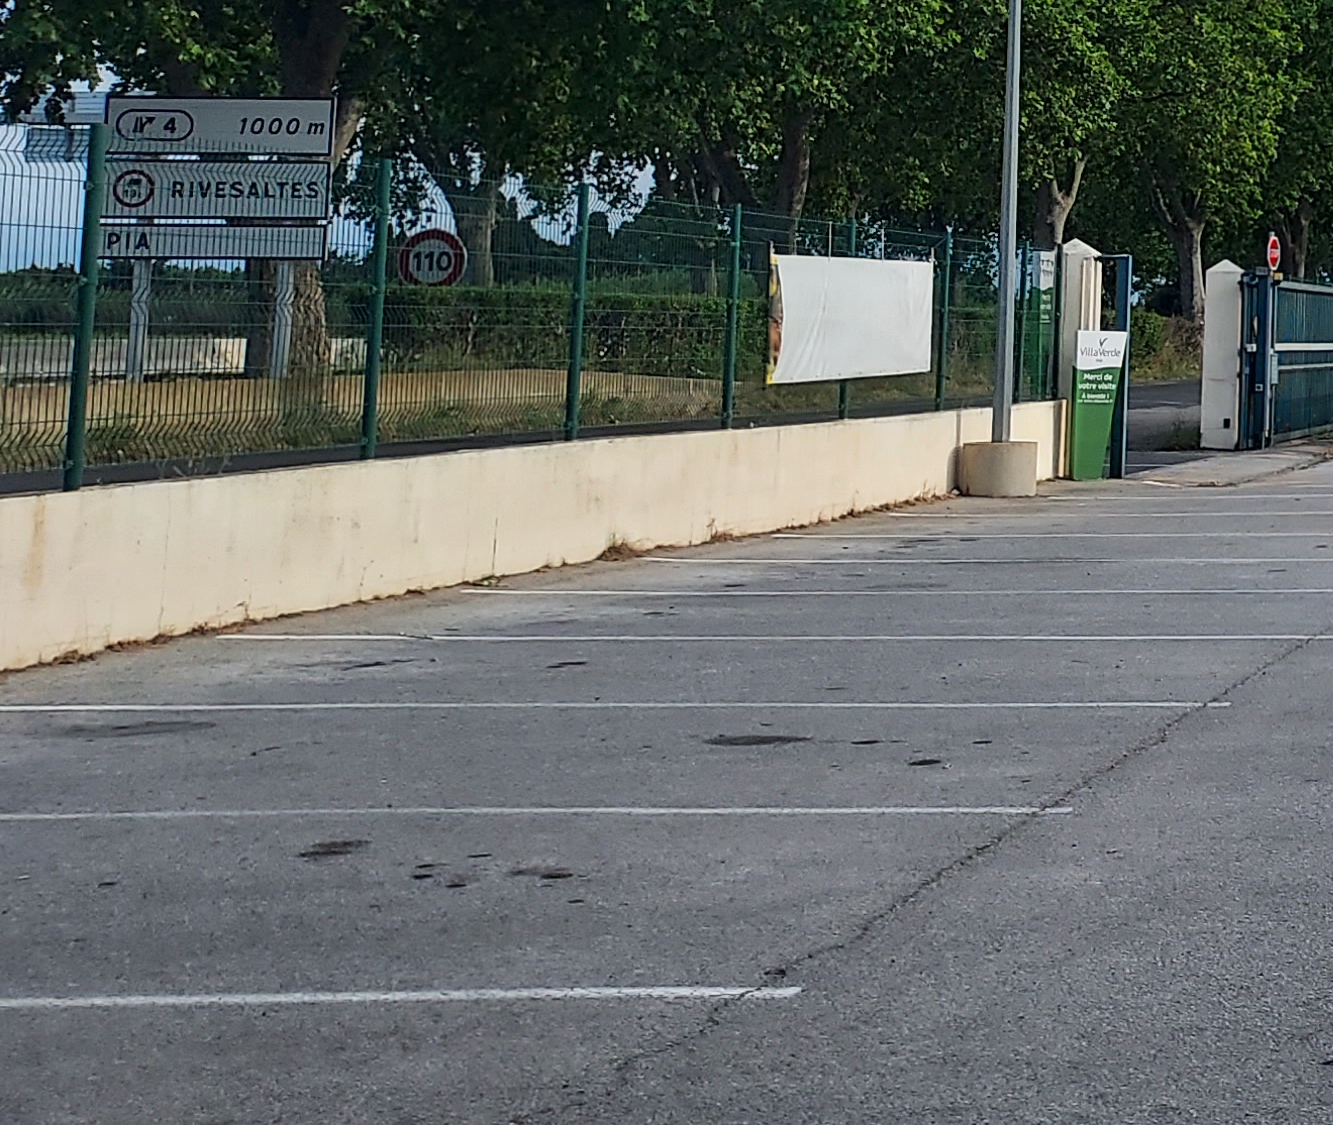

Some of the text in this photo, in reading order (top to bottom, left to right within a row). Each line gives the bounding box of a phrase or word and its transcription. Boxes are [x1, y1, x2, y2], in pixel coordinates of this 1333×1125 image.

[163, 118, 177, 133] 4
[240, 118, 325, 135] 1000 m
[170, 181, 319, 199] RIVESALTES
[106, 232, 150, 250] PIA
[413, 251, 452, 271] 110
[1083, 373, 1113, 381] Merci de
[1079, 382, 1117, 390] votre visite
